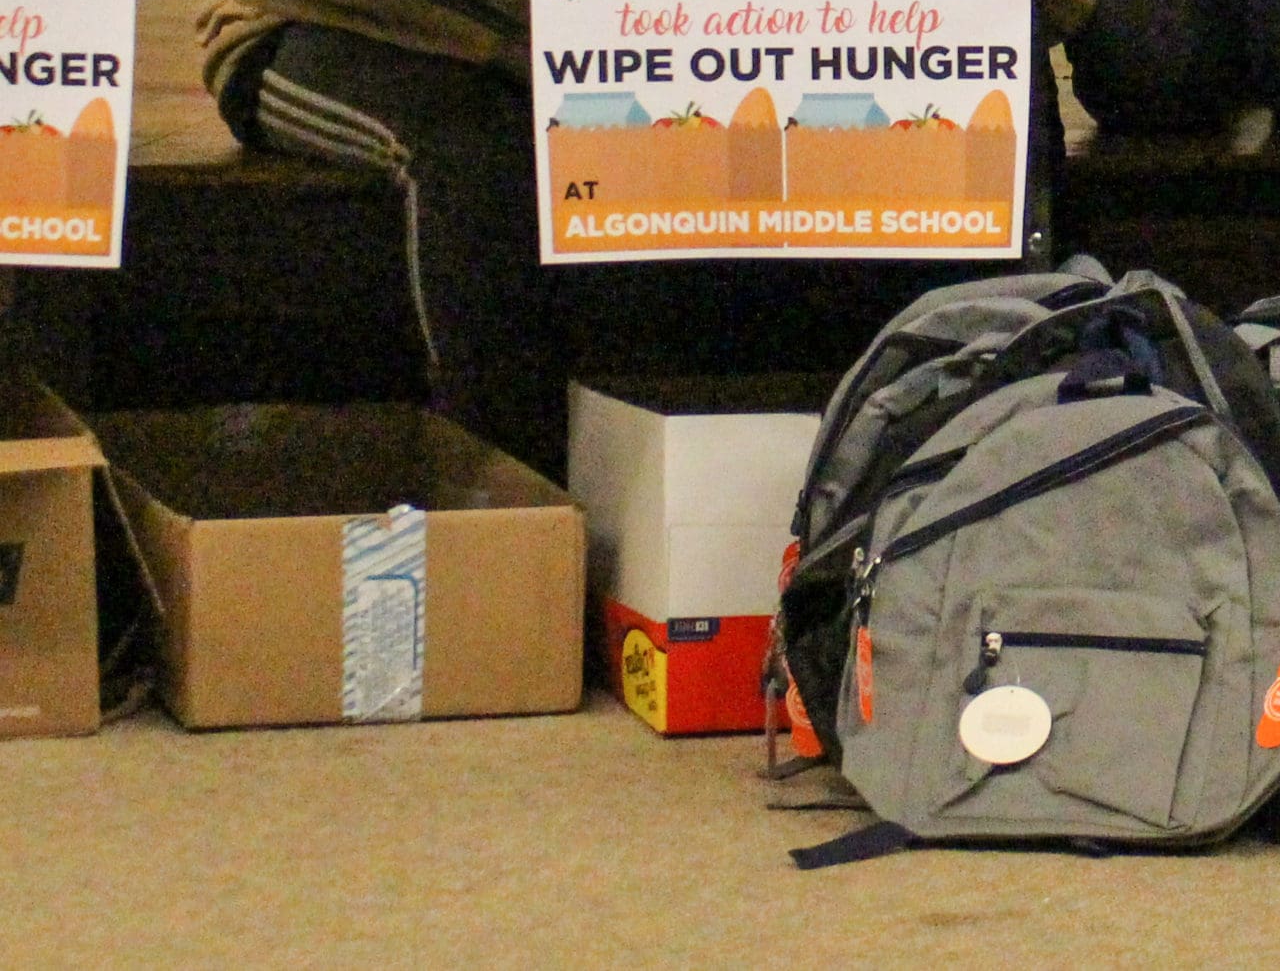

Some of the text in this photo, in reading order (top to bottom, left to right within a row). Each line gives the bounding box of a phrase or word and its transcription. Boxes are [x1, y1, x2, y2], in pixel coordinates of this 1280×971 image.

[615, 0, 945, 51] took action to help
[544, 45, 1018, 84] WIPE OUT HUNGER
[564, 180, 599, 201] AT
[0, 216, 102, 242] CHOOL
[565, 210, 1002, 239] ALGONQUIN MIDDLE SCHOOL
